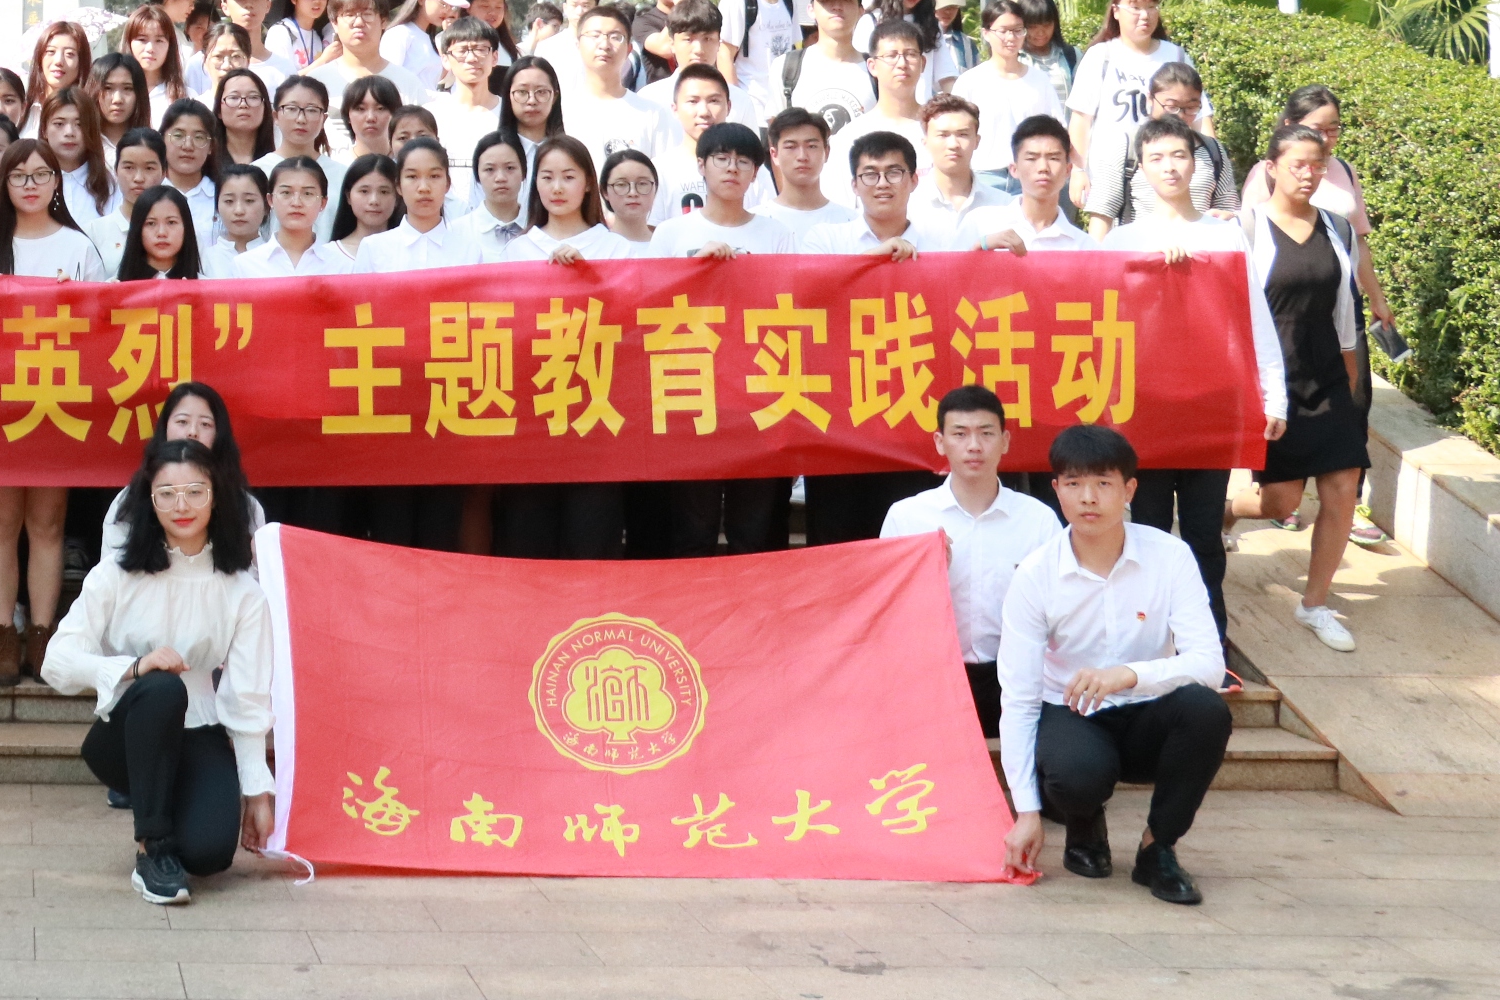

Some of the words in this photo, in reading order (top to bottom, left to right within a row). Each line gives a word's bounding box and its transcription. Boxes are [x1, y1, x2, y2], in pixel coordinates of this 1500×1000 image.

[321, 289, 1137, 439] 主题教育实践活动
[545, 651, 571, 707] HAINAN
[571, 629, 634, 654] NORMAL
[640, 635, 693, 707] UNIVERSITY
[562, 730, 678, 762] 海南师范大学
[342, 761, 939, 858] 海南师范大学
